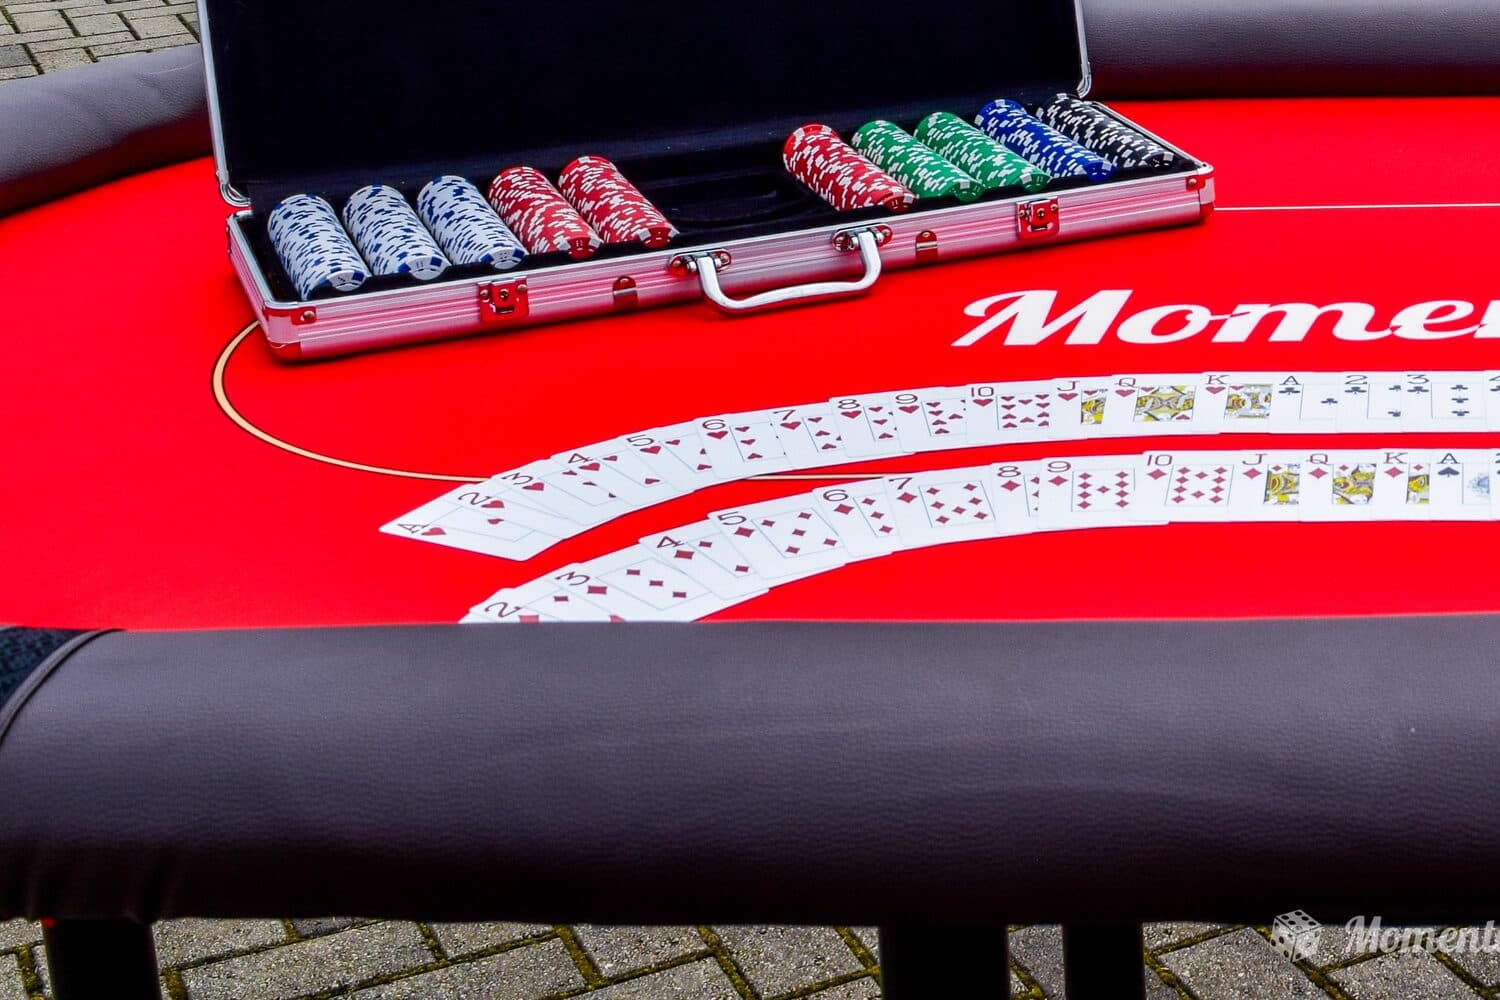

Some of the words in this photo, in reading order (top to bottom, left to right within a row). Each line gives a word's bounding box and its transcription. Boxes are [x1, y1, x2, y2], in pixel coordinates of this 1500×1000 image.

[1113, 376, 1137, 388] Q
[1206, 374, 1229, 384] K
[1279, 375, 1301, 385] A
[1344, 374, 1369, 384] 2
[1406, 373, 1430, 384] 3
[970, 386, 995, 397] 10
[1056, 380, 1079, 391] J
[837, 398, 861, 409] 8
[895, 393, 919, 404] 9
[772, 409, 796, 421] 7
[701, 419, 727, 430] 6
[625, 434, 655, 446] 5
[568, 452, 594, 463] 4
[1146, 454, 1173, 465] 10
[1241, 453, 1266, 465] J
[1305, 453, 1329, 465] Q
[1383, 452, 1407, 464] K
[1437, 452, 1461, 464] A
[996, 465, 1022, 477] 8
[1047, 460, 1072, 472] 9
[501, 473, 533, 484] 3
[887, 477, 913, 490] 7
[457, 491, 493, 505] 2
[822, 488, 849, 501] 6
[717, 511, 748, 525] 5
[398, 523, 429, 534] A
[656, 535, 685, 548] 4
[554, 571, 591, 585] 3
[484, 601, 522, 618] 2
